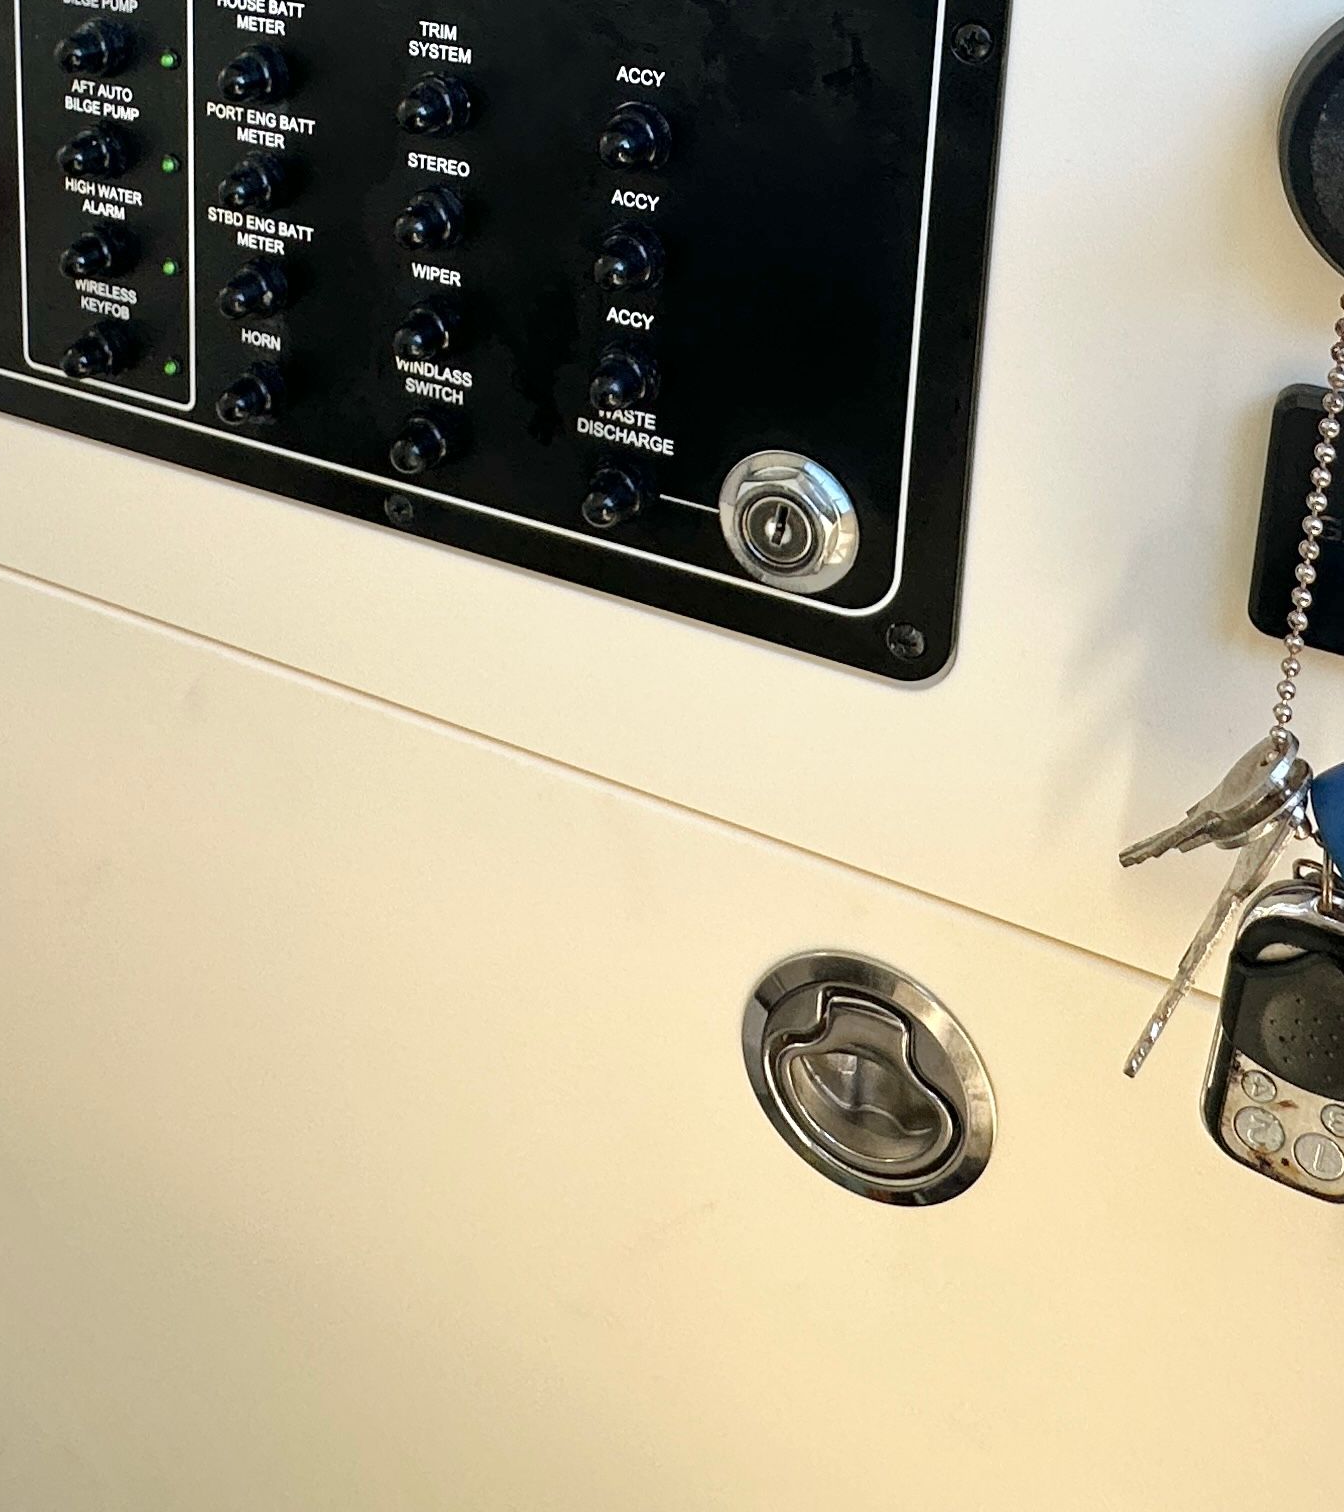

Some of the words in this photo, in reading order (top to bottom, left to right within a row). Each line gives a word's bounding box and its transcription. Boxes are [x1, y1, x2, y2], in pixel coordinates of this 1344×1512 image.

[268, 0, 304, 19] BATT
[237, 14, 285, 36] METER
[419, 21, 457, 41] TRIM
[408, 40, 471, 64] SYSTEM
[616, 66, 665, 88] ACCY
[71, 79, 97, 97] AFT
[100, 83, 133, 103] AUTO
[65, 96, 100, 116] BILGE
[102, 103, 139, 122] PUMP
[206, 102, 245, 123] PORT
[247, 108, 275, 128] ENG
[278, 114, 315, 136] BATT
[237, 126, 285, 149] METER
[408, 152, 470, 177] STEREO
[65, 177, 95, 197] HIGH
[97, 182, 143, 206] WATER
[611, 189, 659, 212] ACCY
[82, 199, 125, 221] ALARM
[208, 207, 243, 229] STBD
[246, 213, 275, 236] ENG
[277, 220, 314, 242] BATT
[237, 233, 285, 256] METER
[411, 262, 461, 287] WIPER
[75, 278, 137, 305] WIRELESS
[81, 295, 130, 320] KEYFOB
[606, 307, 654, 330] ACCY
[241, 328, 281, 351] HORN
[395, 355, 473, 388] WINDLASS
[405, 377, 464, 405] SWITCH
[577, 417, 675, 456] DISCHARGE
